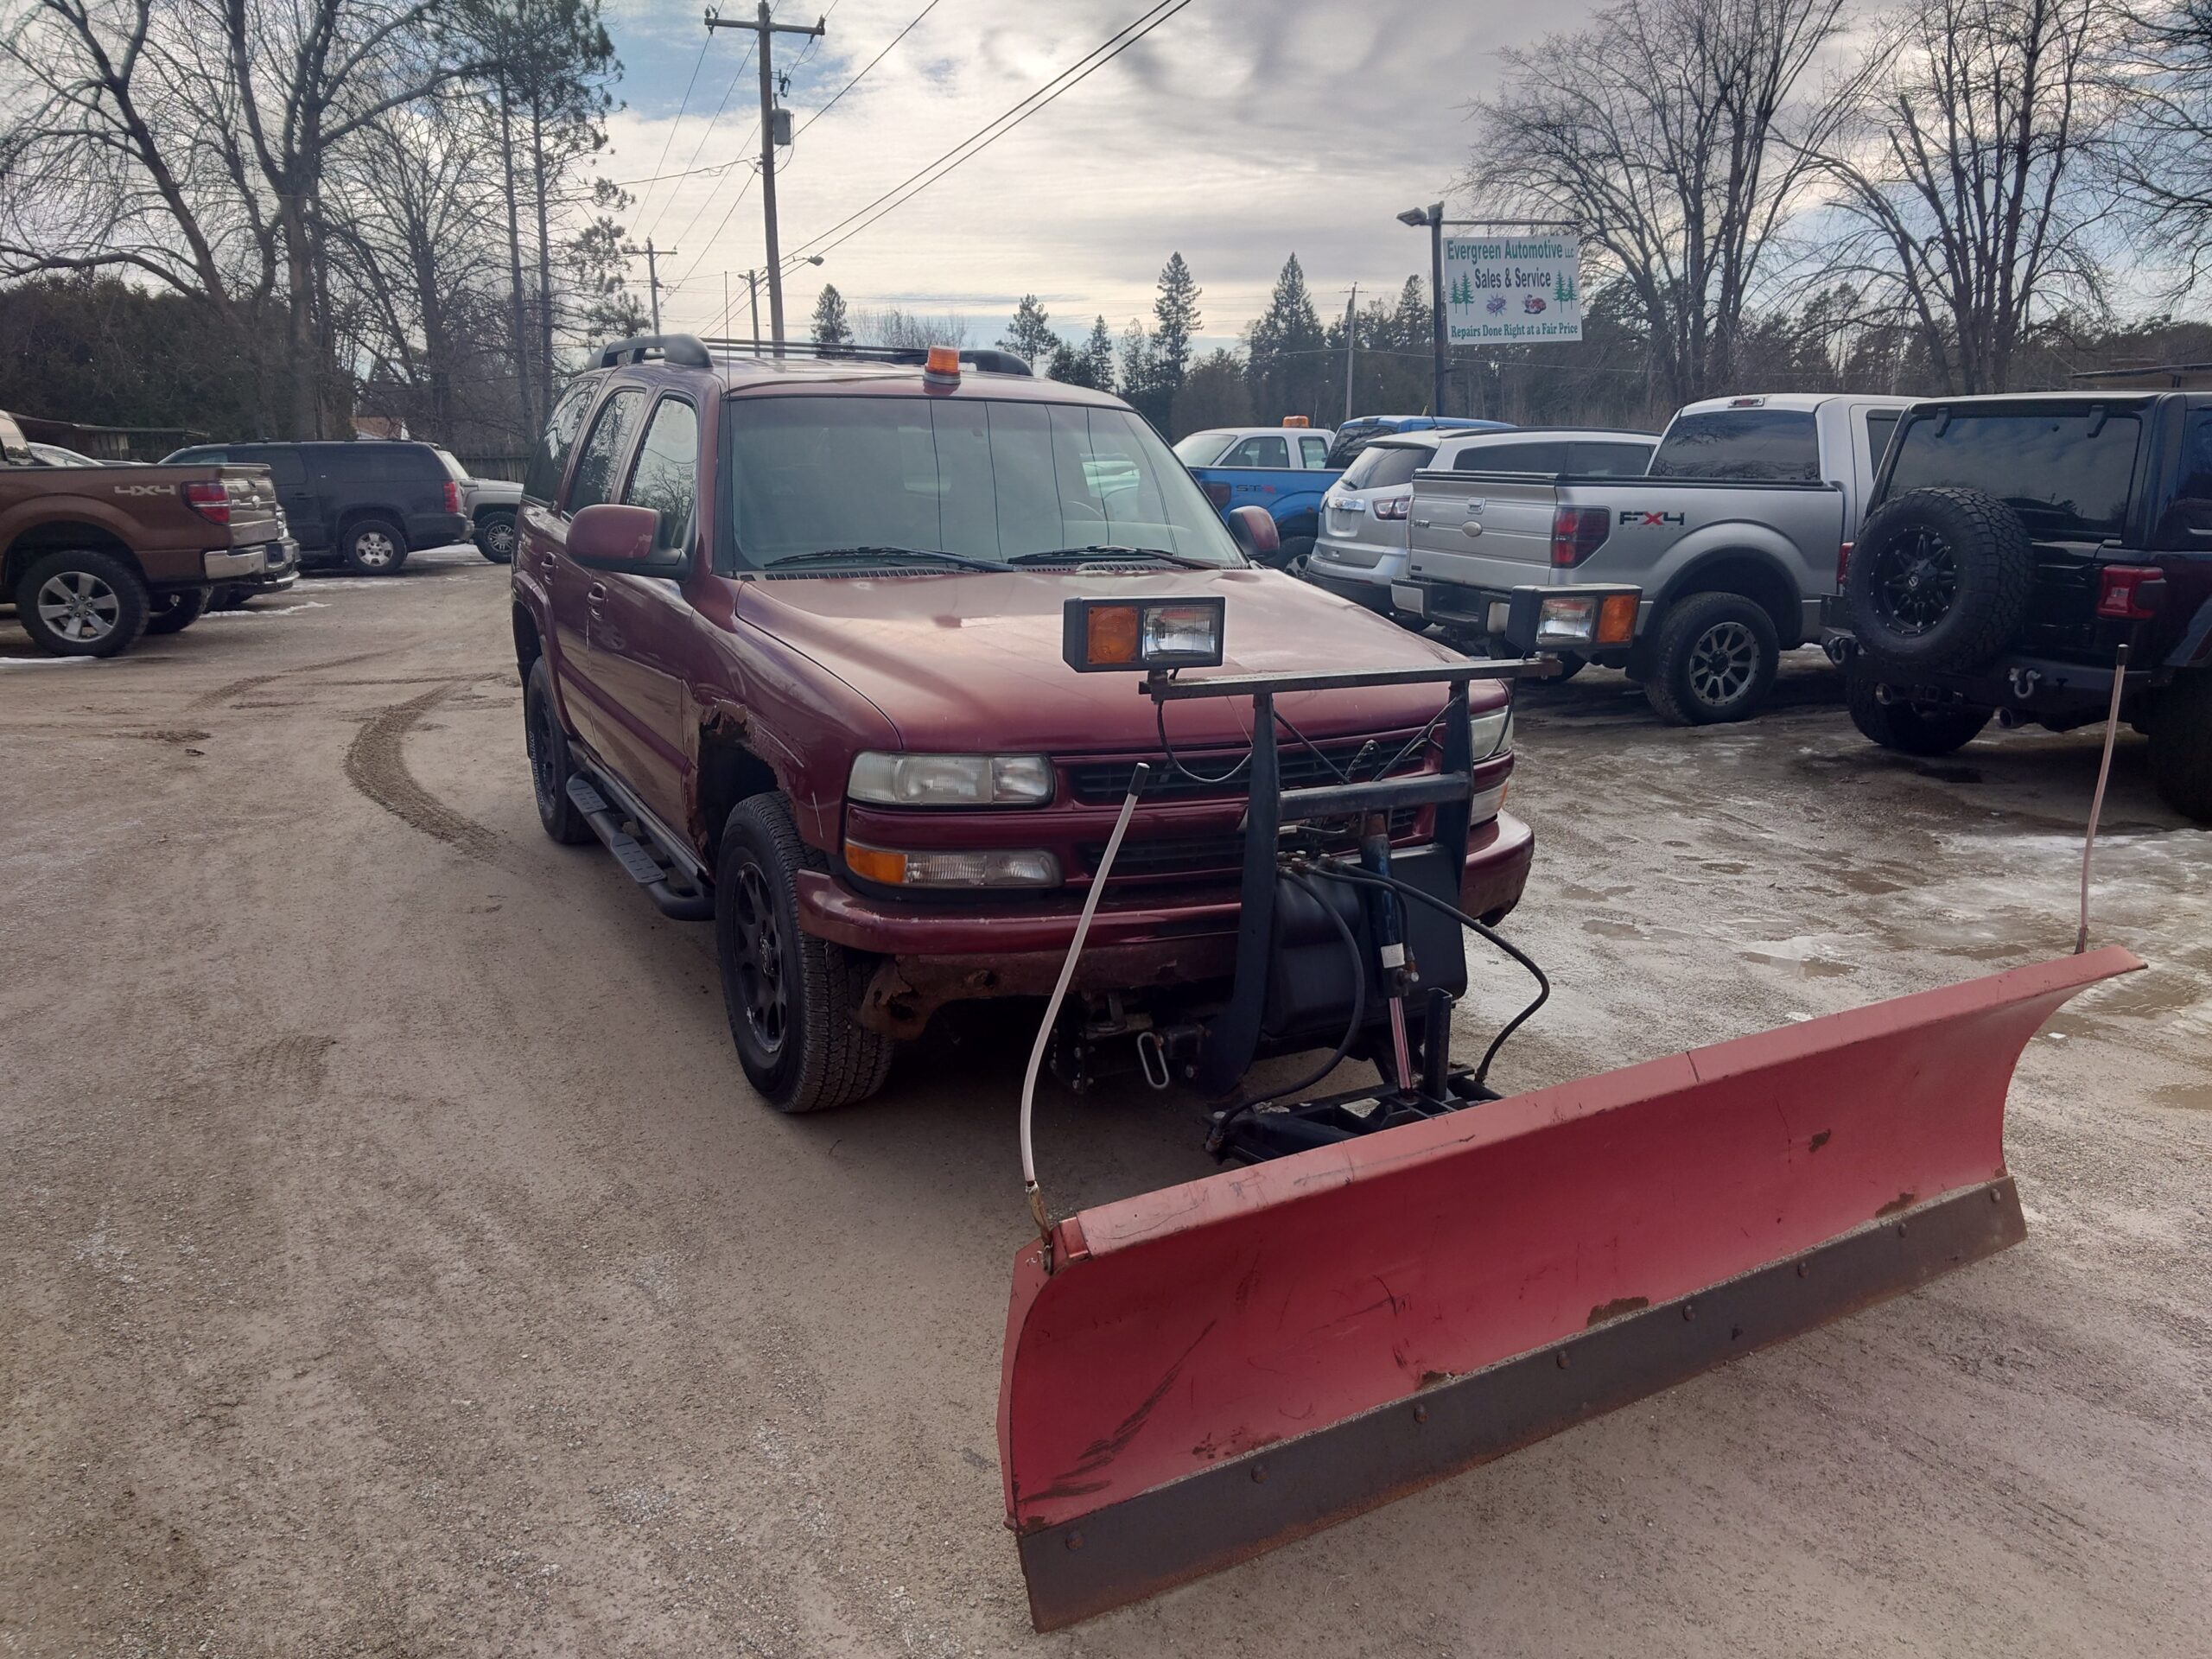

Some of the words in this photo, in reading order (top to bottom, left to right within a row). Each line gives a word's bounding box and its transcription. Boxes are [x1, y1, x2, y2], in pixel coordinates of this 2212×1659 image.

[1447, 239, 1502, 265] Evergreen
[1504, 238, 1563, 259] Automotive
[1565, 248, 1574, 258] LLC
[1474, 268, 1502, 289] Sales
[1504, 267, 1512, 288] &
[1515, 266, 1551, 288] Service
[1451, 325, 1481, 340] Repairs
[1483, 324, 1503, 337] Done
[1503, 323, 1525, 339] Right
[1527, 324, 1535, 335] at
[1535, 326, 1541, 335] a
[1541, 322, 1558, 335] Fair
[1559, 321, 1578, 334] Price
[1618, 511, 1686, 526] FX4
